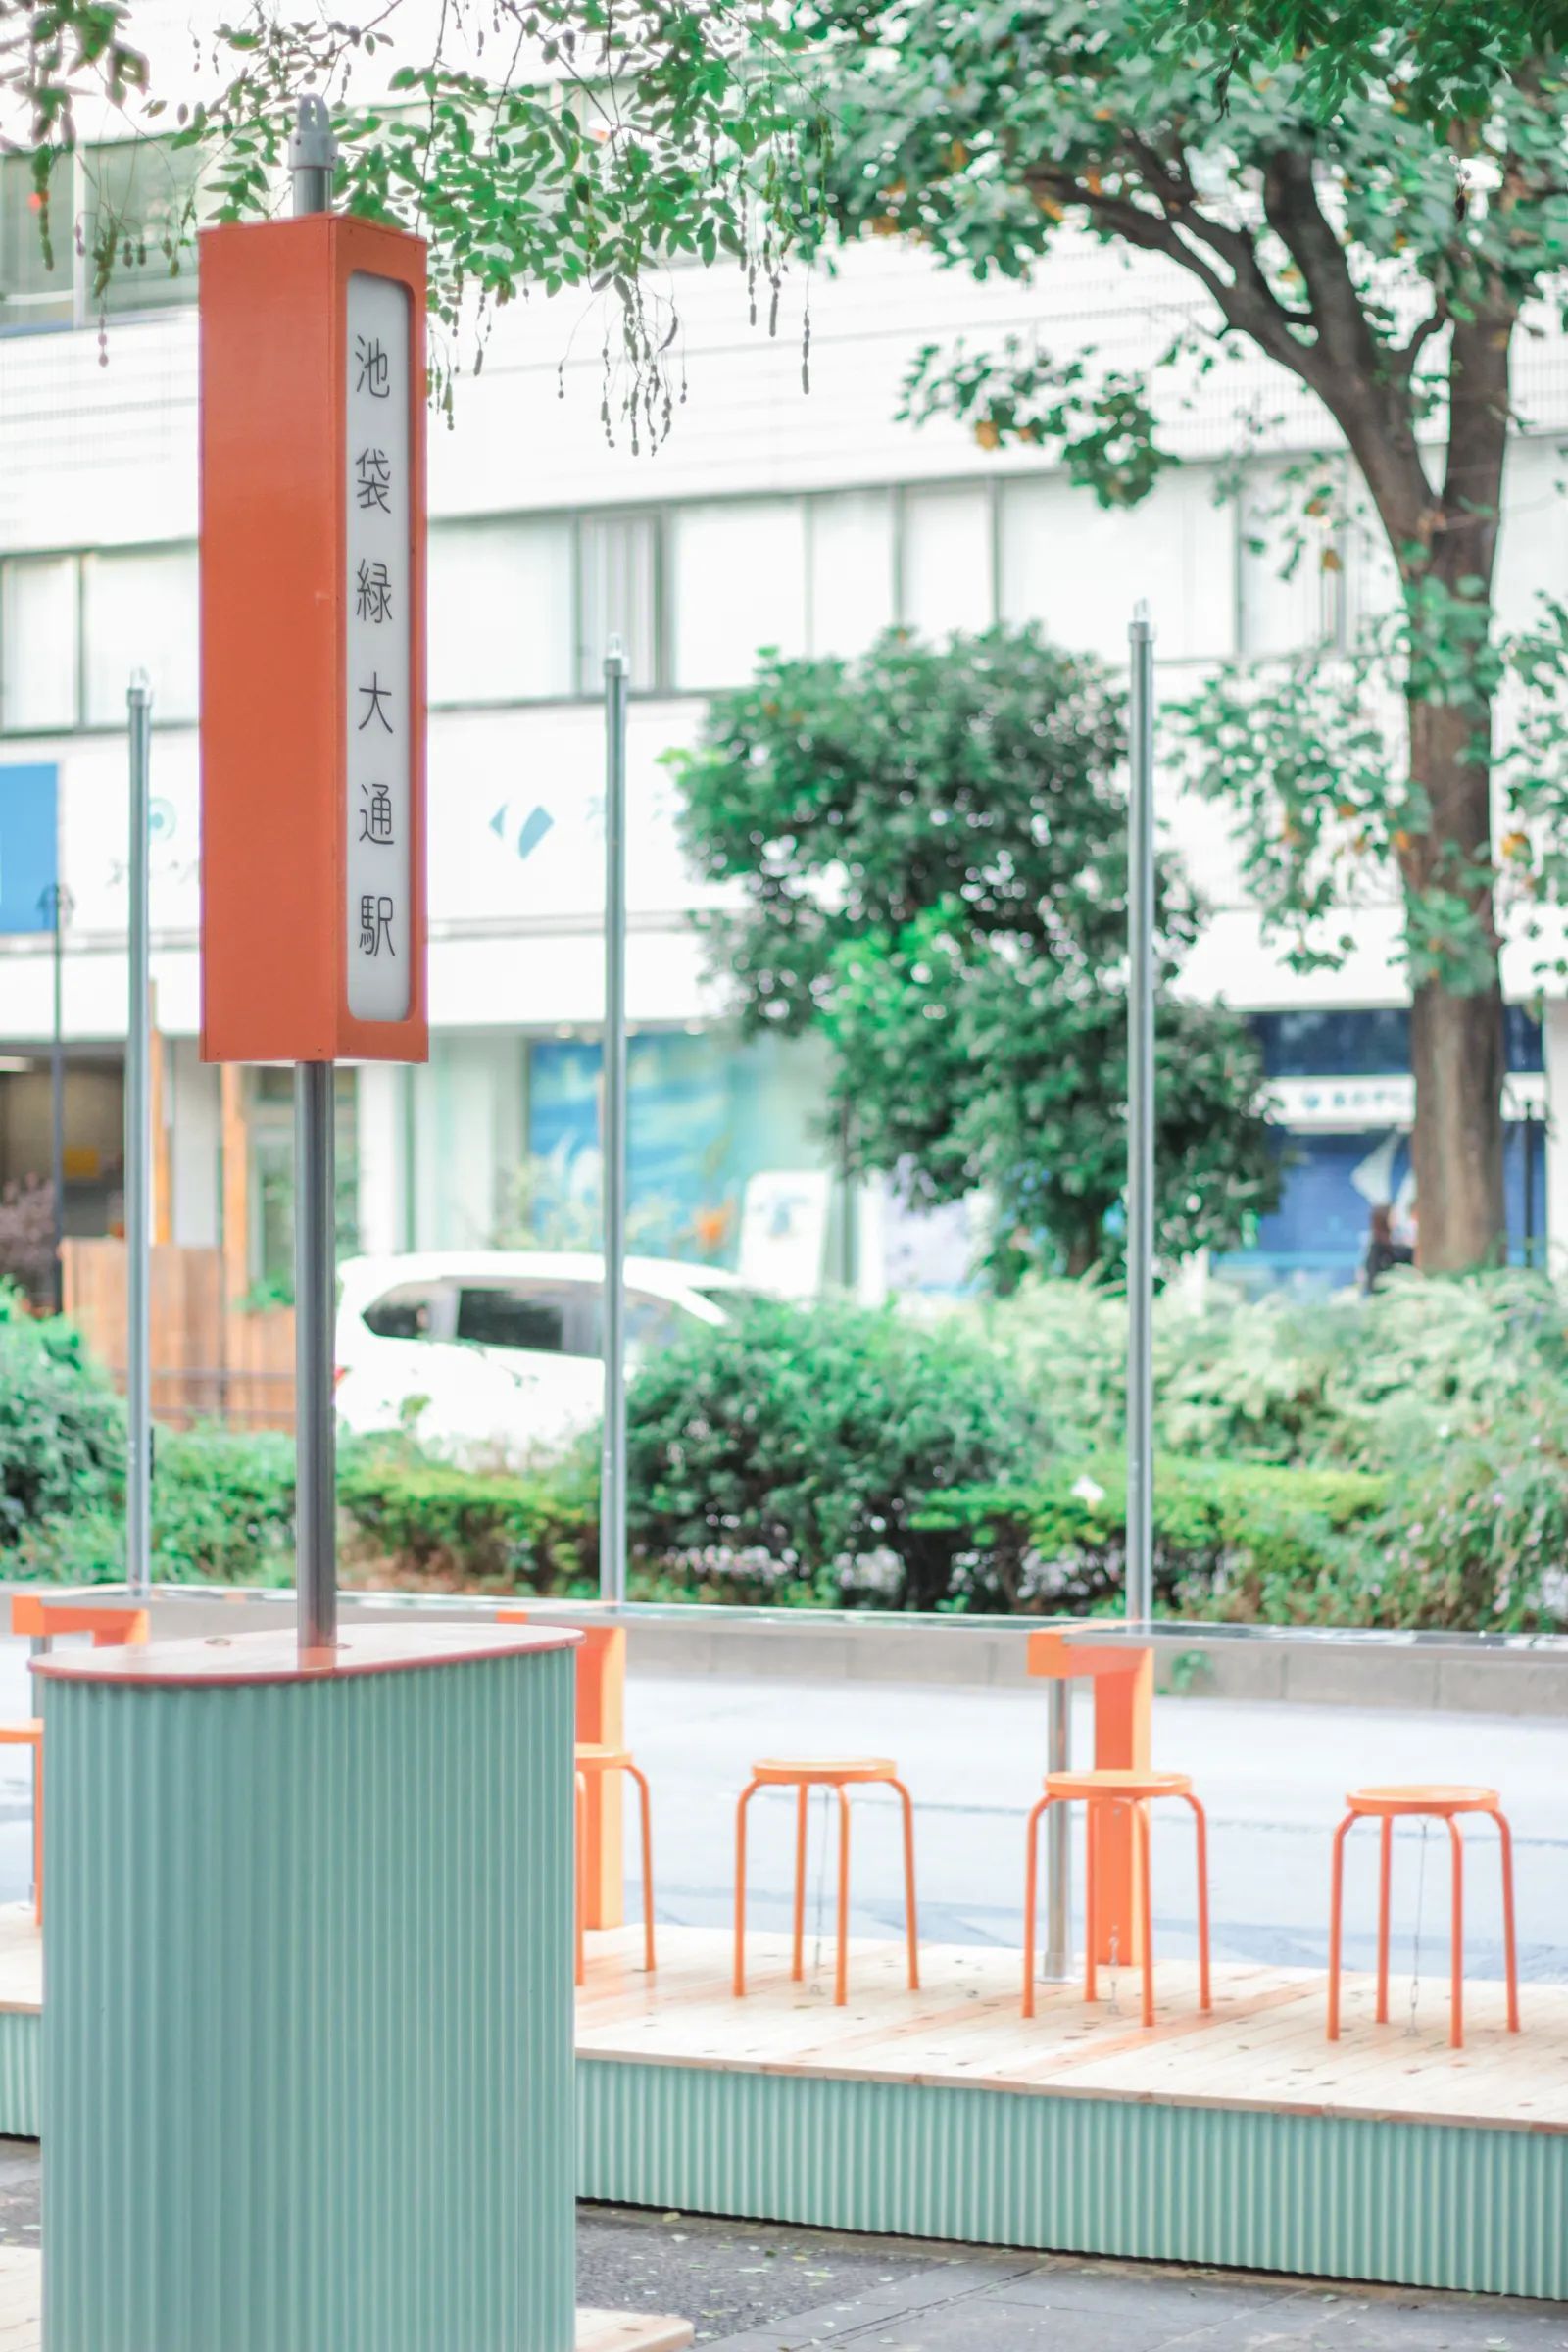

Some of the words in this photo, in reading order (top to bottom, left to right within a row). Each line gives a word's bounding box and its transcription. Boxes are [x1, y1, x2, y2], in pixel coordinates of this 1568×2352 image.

[355, 334, 396, 957] 池袋緑大通駅
